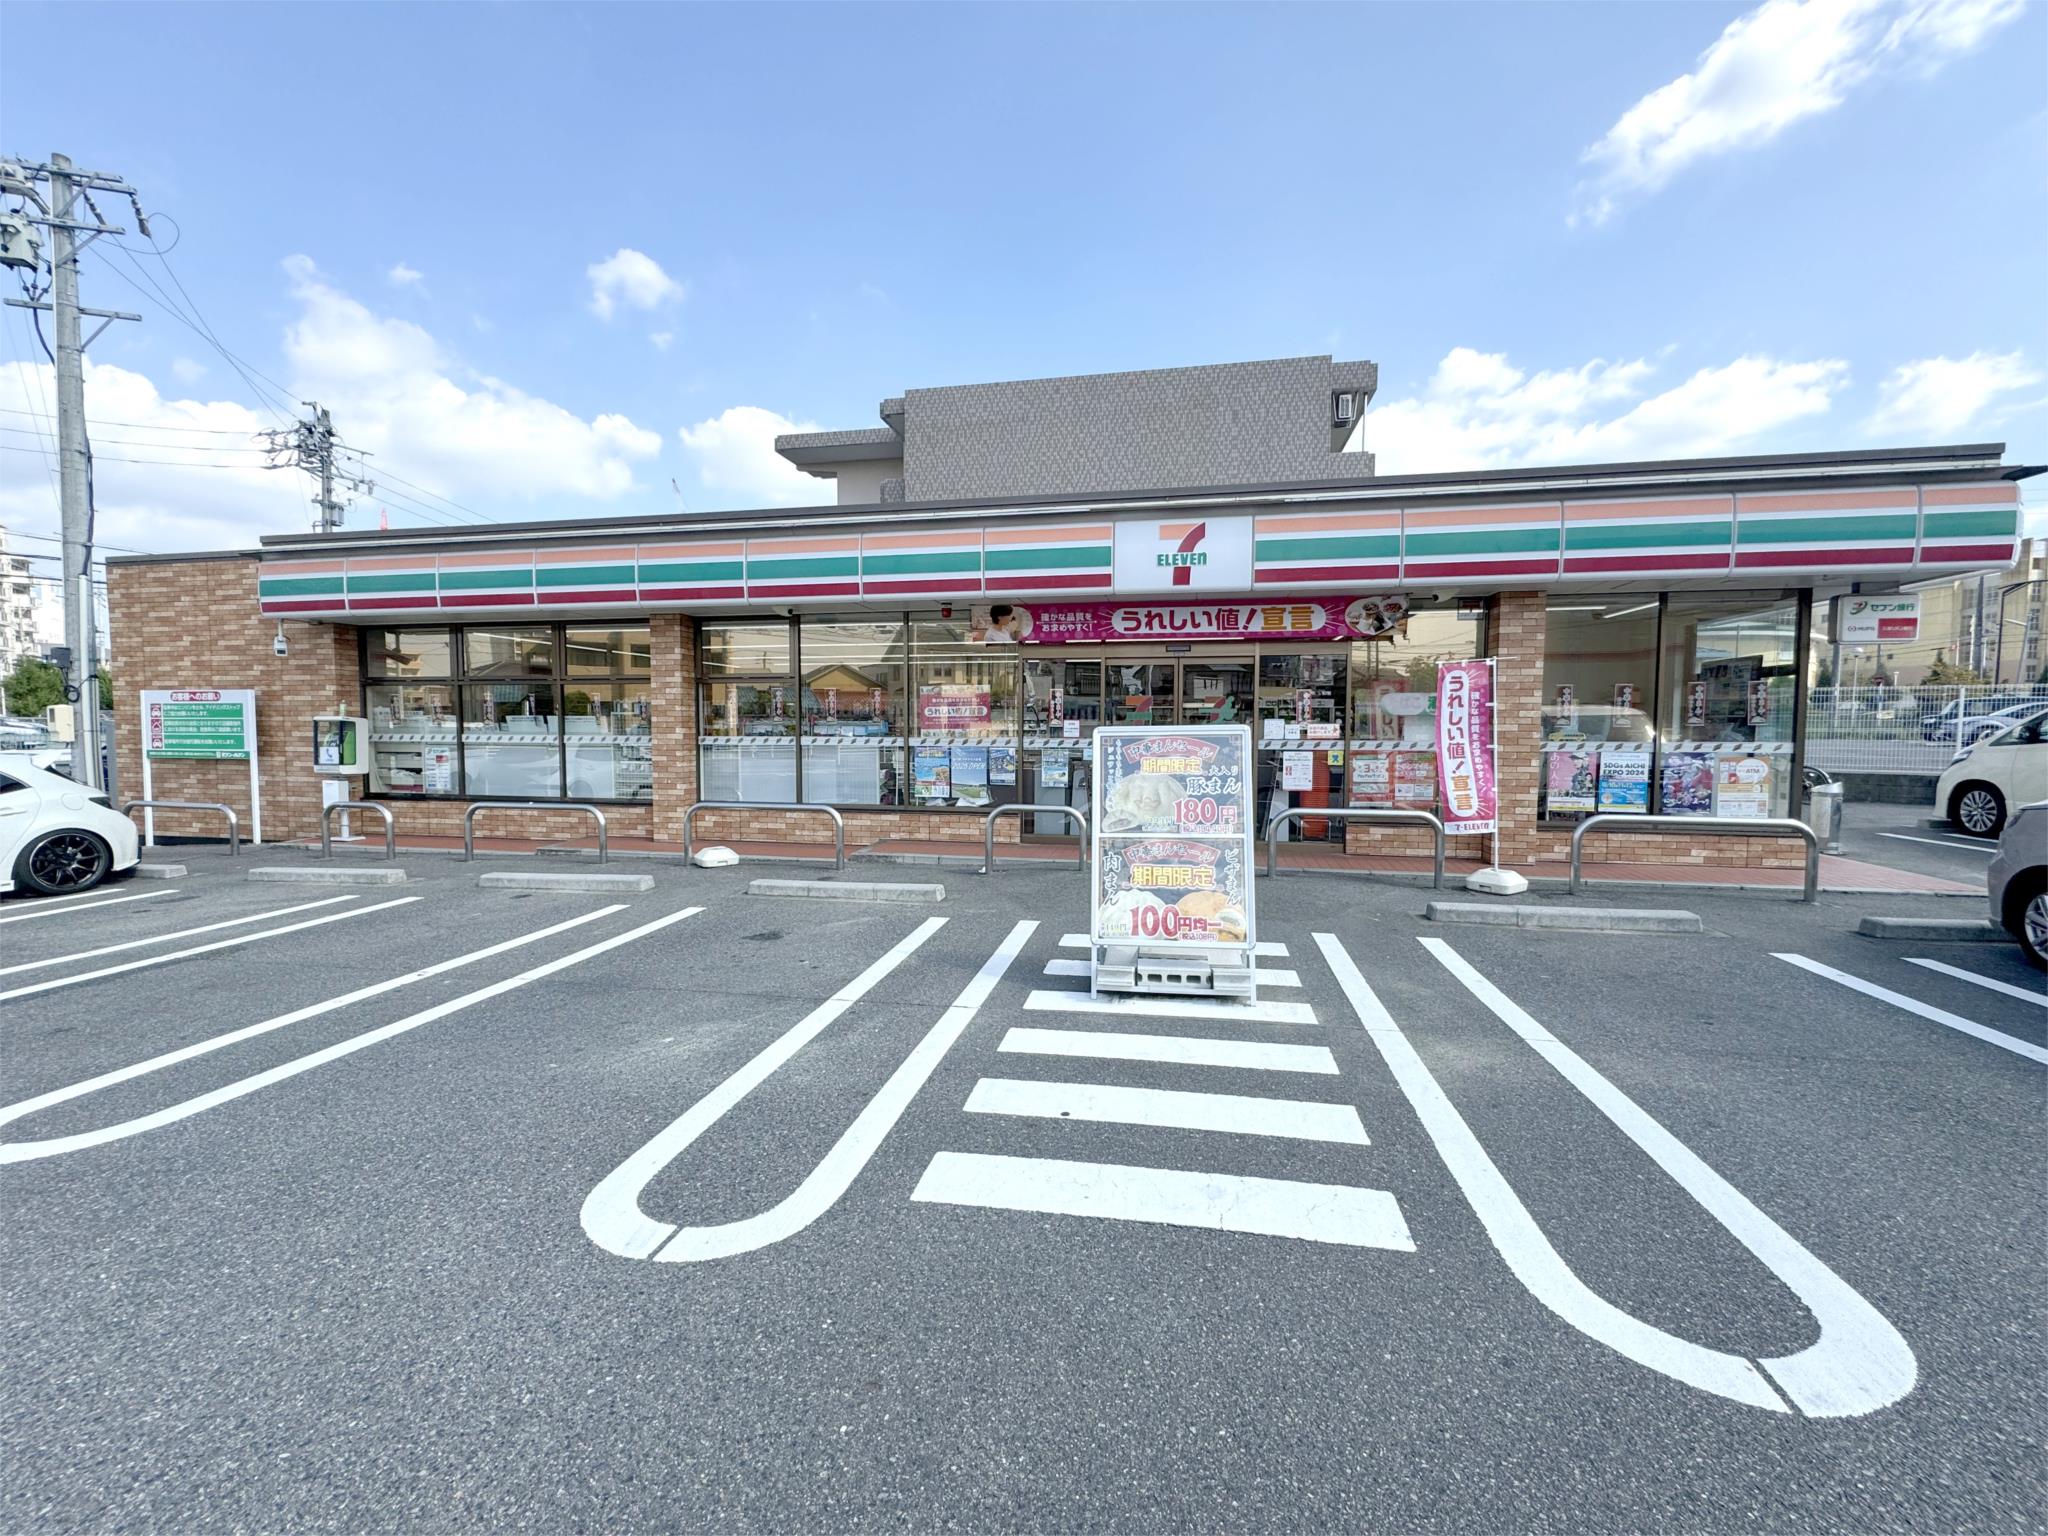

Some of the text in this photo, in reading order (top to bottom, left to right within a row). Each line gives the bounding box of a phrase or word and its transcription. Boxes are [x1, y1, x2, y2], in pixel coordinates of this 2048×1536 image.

[1040, 611, 1093, 623] 確かな品質を
[1870, 602, 1916, 612] セブン銀行
[1142, 757, 1202, 774] 期間限定
[1186, 777, 1242, 794] 豚まん
[1174, 798, 1238, 824] 180円
[1102, 851, 1122, 906] 肉まん
[1131, 864, 1215, 888] 期間限定
[1129, 904, 1222, 937] 100円均一
